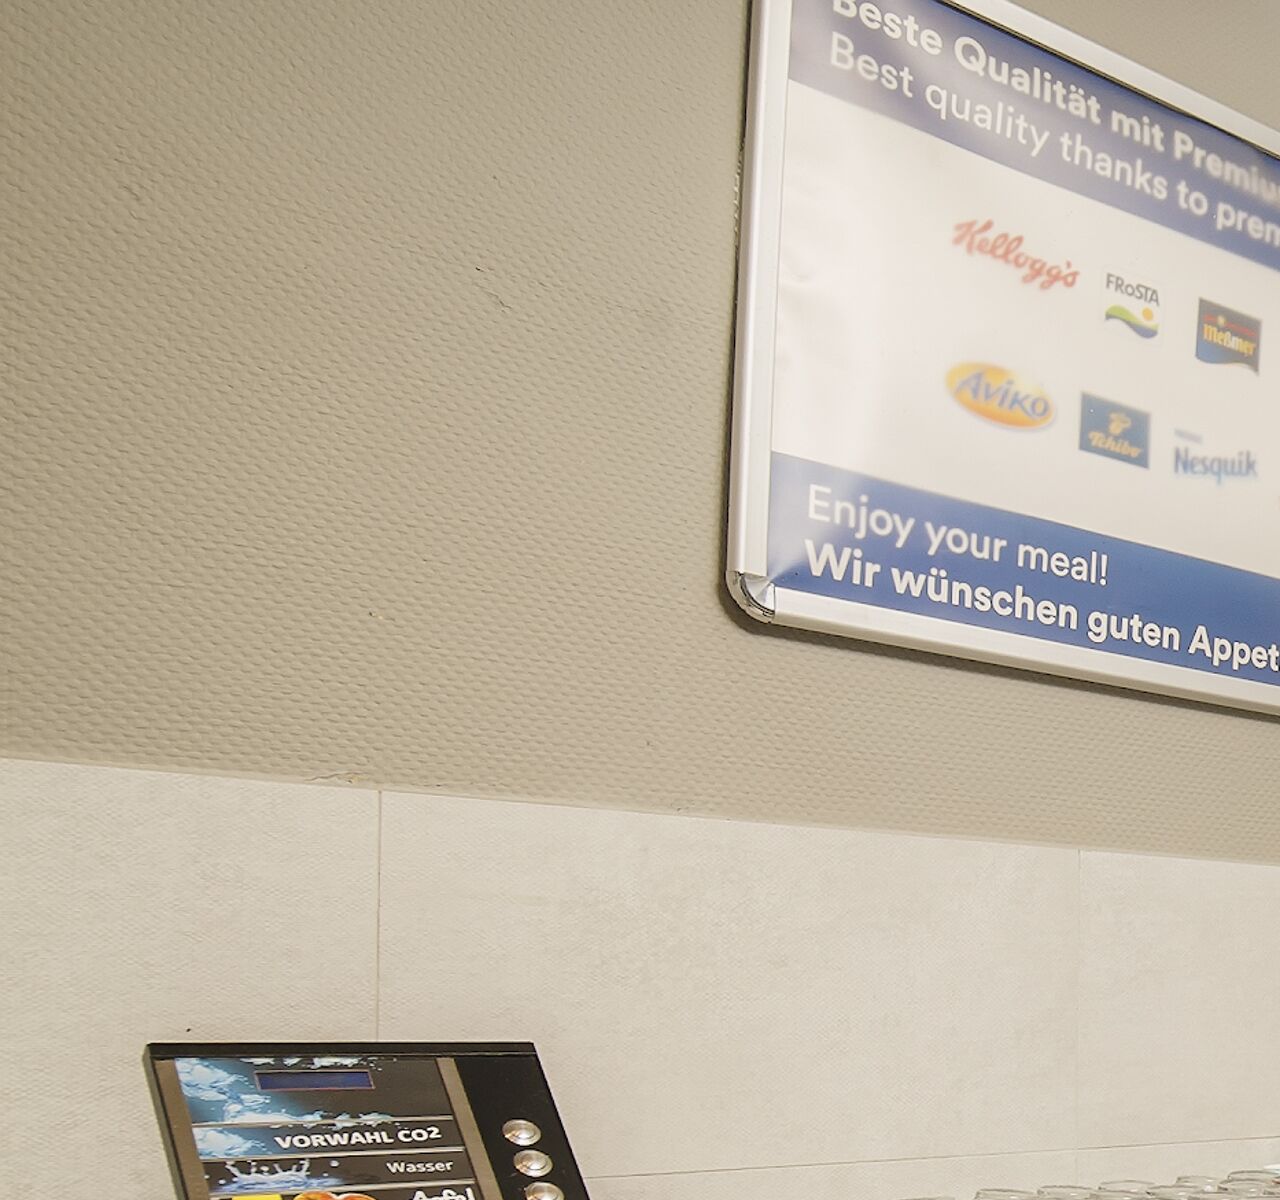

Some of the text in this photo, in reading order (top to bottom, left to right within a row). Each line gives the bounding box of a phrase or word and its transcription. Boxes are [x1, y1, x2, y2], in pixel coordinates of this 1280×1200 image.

[829, 31, 914, 98] Best
[924, 84, 1050, 157] quality
[1059, 131, 1169, 201] thanks
[1176, 178, 1209, 217] to
[954, 36, 1102, 125] Qualität
[1111, 109, 1165, 152] mit
[953, 219, 1080, 290] Kellogg's
[1203, 322, 1257, 358] Meßmer
[954, 370, 1051, 420] Aviko
[1173, 446, 1258, 486] Nesquik
[808, 483, 1109, 586] Enjoy your meal!
[804, 538, 882, 588] Wir
[891, 567, 1079, 631] wünschen
[1086, 610, 1182, 651] guten
[274, 1126, 442, 1149] VORWAHL CO2
[386, 1160, 454, 1174] Wasser
